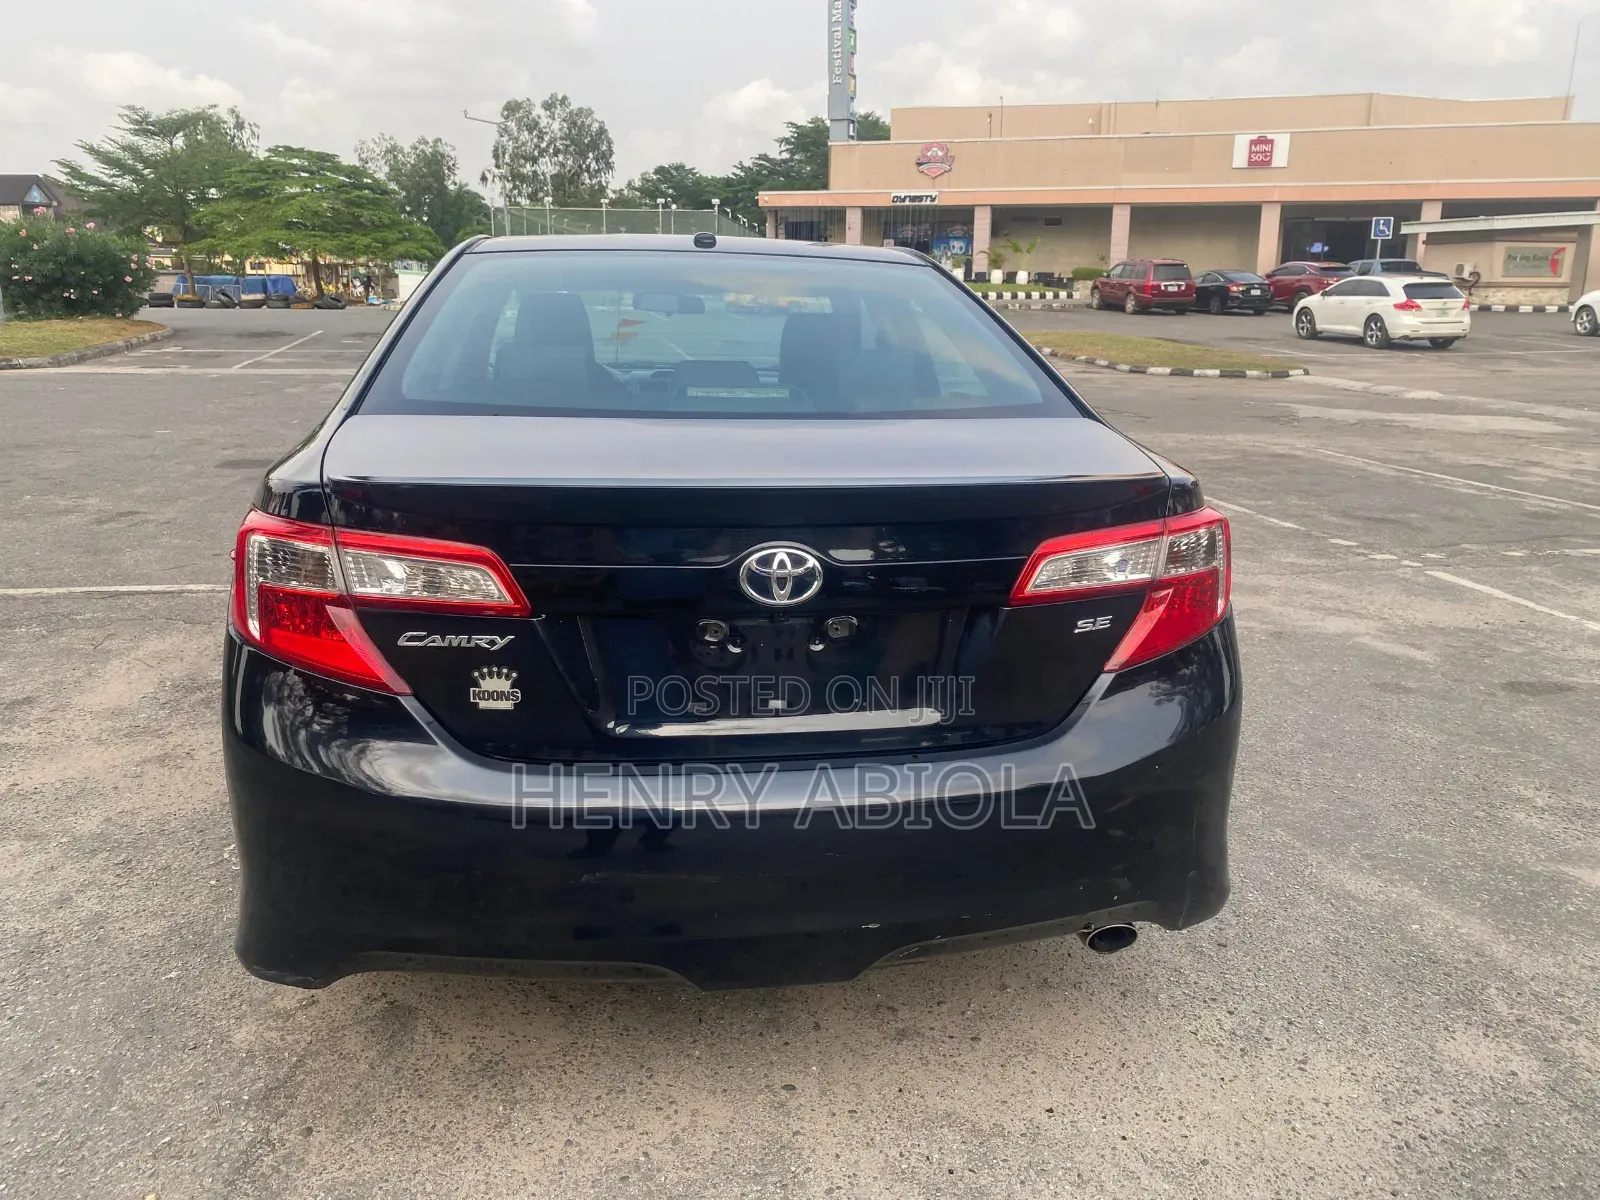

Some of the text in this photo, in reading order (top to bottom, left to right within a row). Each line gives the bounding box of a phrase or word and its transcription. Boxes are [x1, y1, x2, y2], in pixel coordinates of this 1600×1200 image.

[832, 27, 842, 84] Festival
[1251, 143, 1272, 152] MINI
[1073, 615, 1113, 634] SE
[397, 631, 516, 651] CAMRY
[471, 688, 521, 703] KOONS
